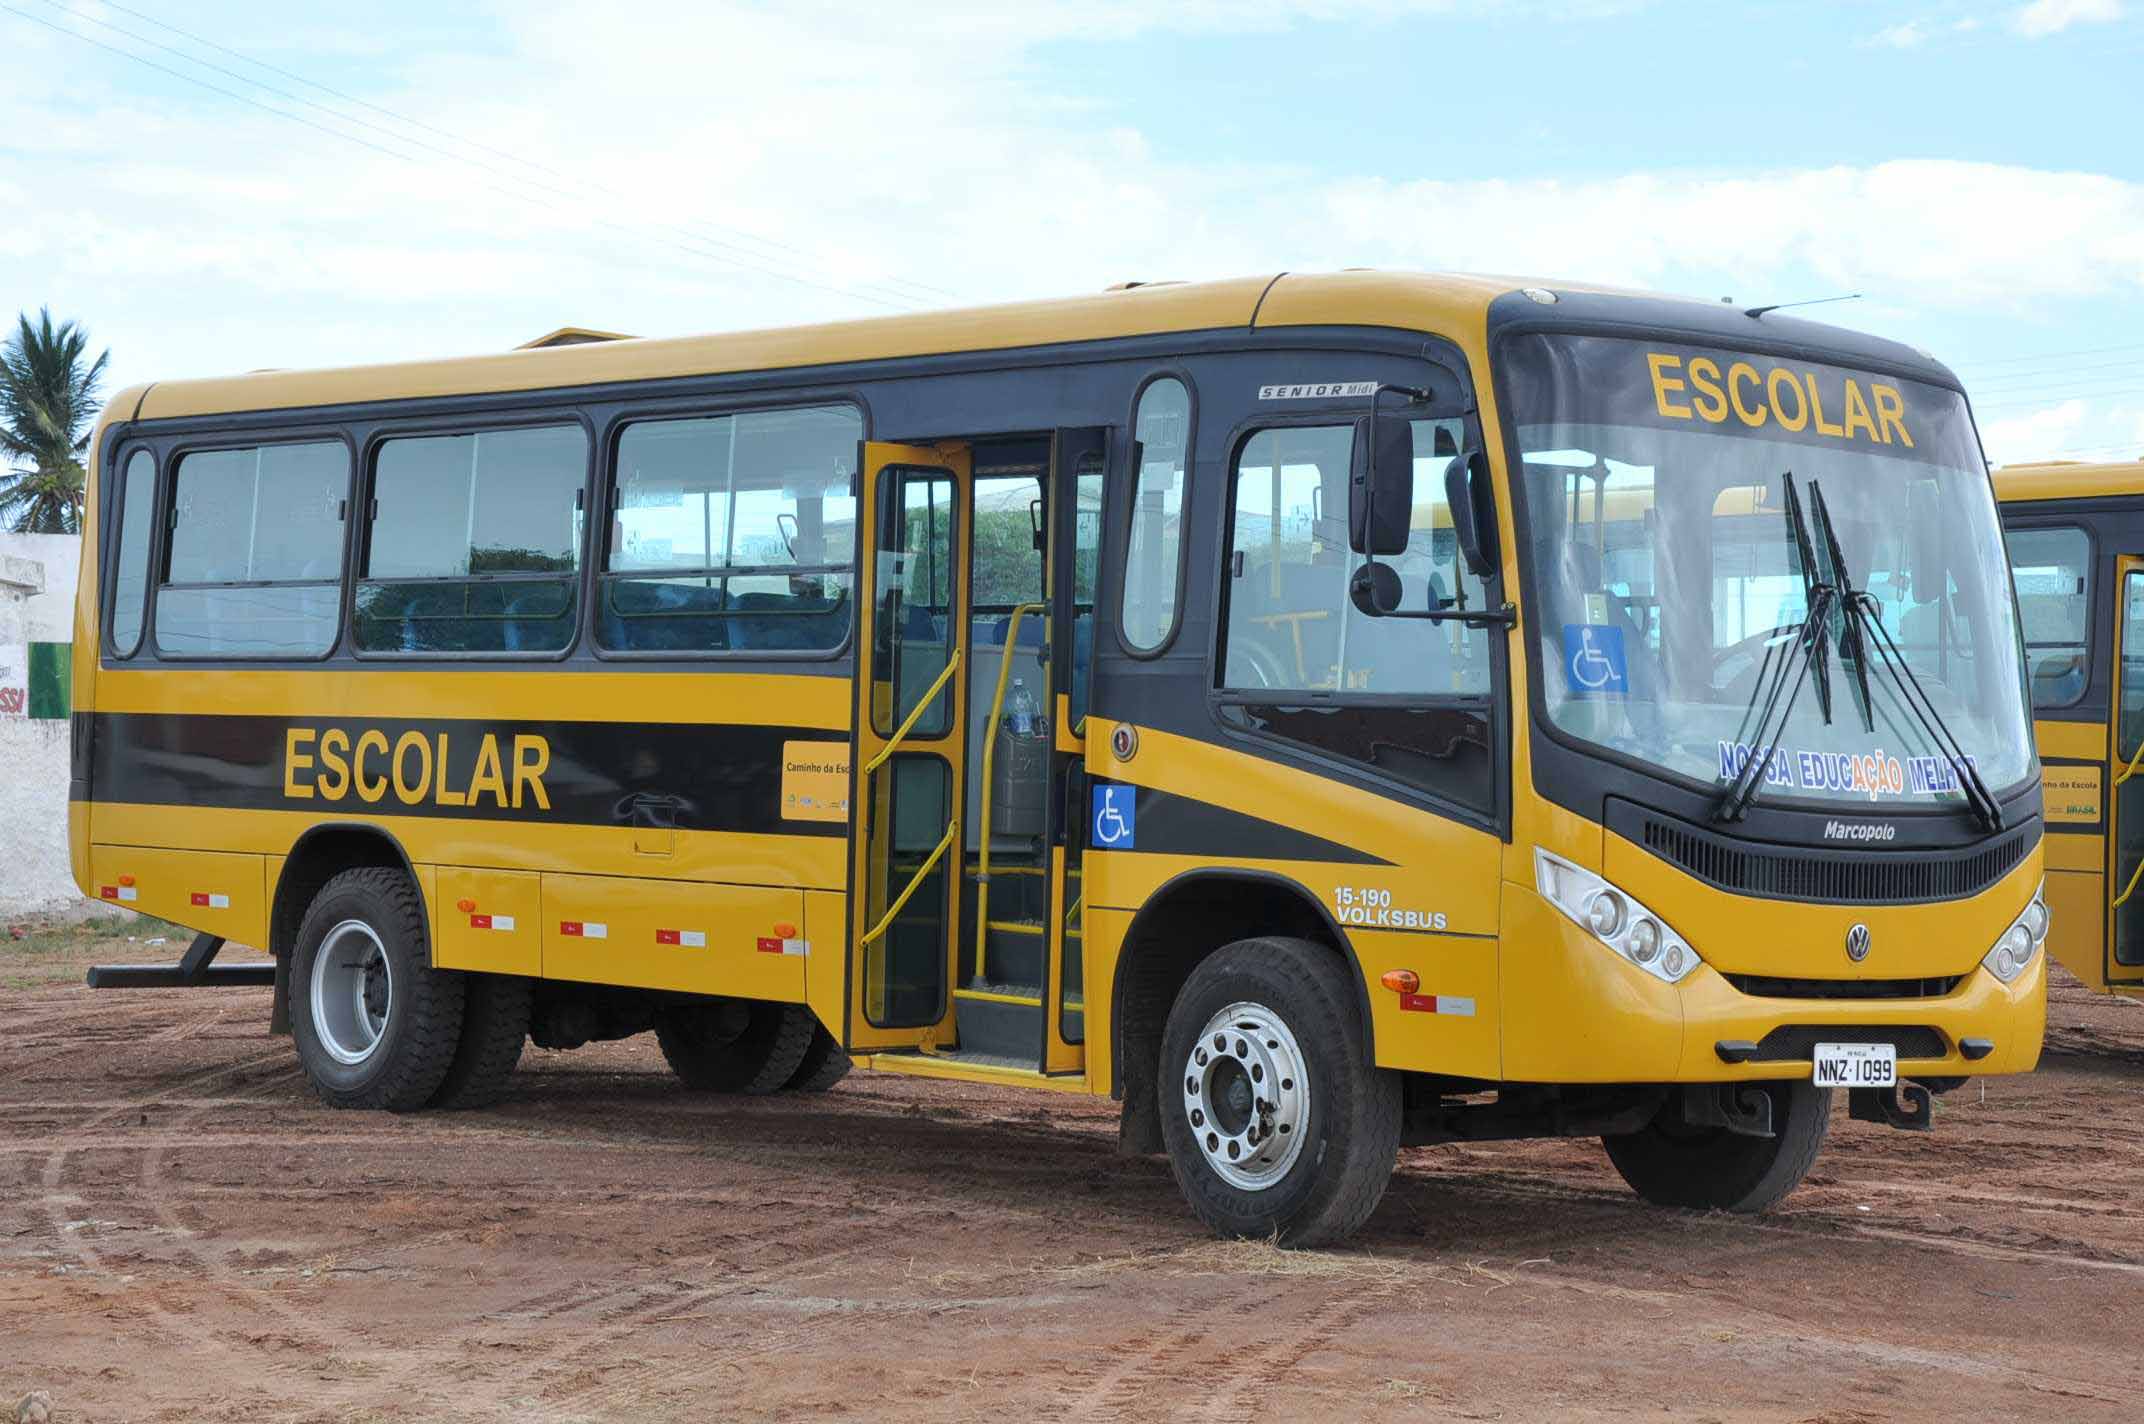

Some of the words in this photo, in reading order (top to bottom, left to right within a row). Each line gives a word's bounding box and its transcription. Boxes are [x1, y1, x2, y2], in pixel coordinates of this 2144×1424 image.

[1262, 384, 1342, 398] SENIOR
[1346, 384, 1373, 396] Midi
[1647, 353, 1914, 448] ESCOLAR
[284, 727, 551, 810] ESCOLAR
[786, 762, 822, 773] Caminho
[823, 764, 834, 774] da
[1797, 749, 1902, 802] EDUCAÇÃO
[2071, 781, 2098, 790] Escola
[1824, 820, 1896, 842] Marcopolo
[1335, 887, 1391, 908] 15-190
[1337, 907, 1447, 929] VOLKSBUS
